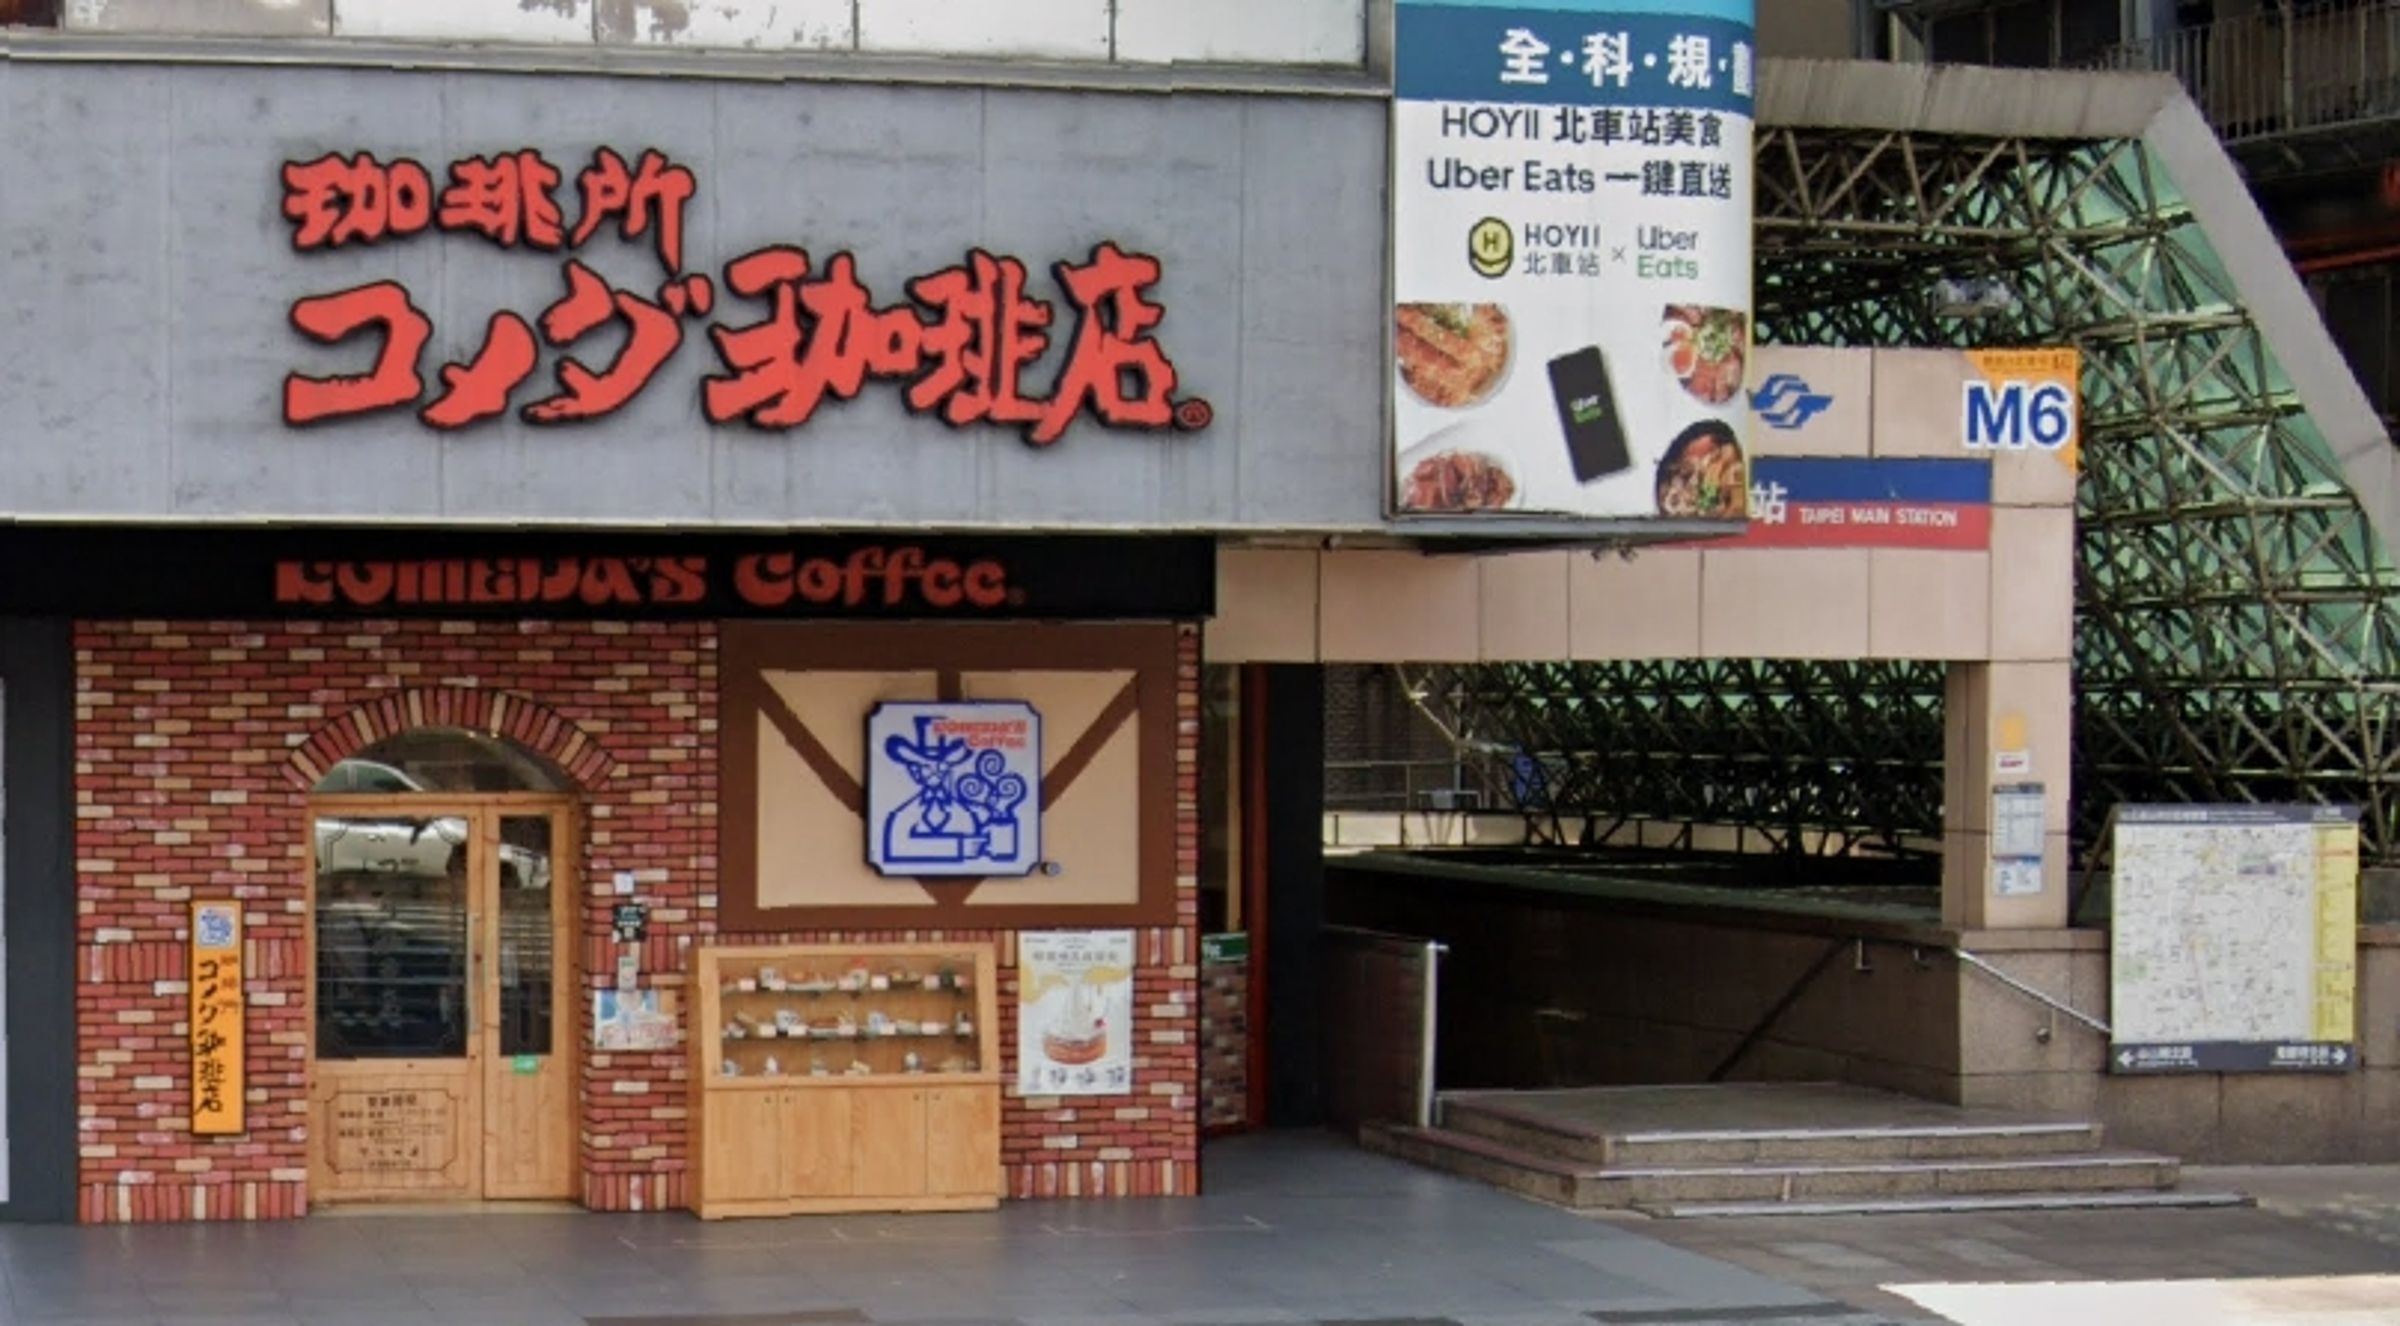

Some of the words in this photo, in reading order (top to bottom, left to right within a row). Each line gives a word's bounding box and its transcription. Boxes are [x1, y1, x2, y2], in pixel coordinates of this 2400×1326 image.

[1553, 107, 1723, 147] 北車站美食
[1427, 158, 1514, 191] Uber
[1523, 160, 1596, 193] Eats
[1605, 160, 1732, 199] 一鍵直送
[284, 149, 695, 271] 珈琲所
[1637, 225, 1699, 250] Uber
[1522, 251, 1601, 277] 北車站
[1636, 254, 1699, 280] Eats
[1967, 386, 2068, 445] M6
[1799, 506, 1845, 525] TAIPEI
[1851, 506, 1890, 525] MAIN
[1895, 507, 1958, 527] STATION
